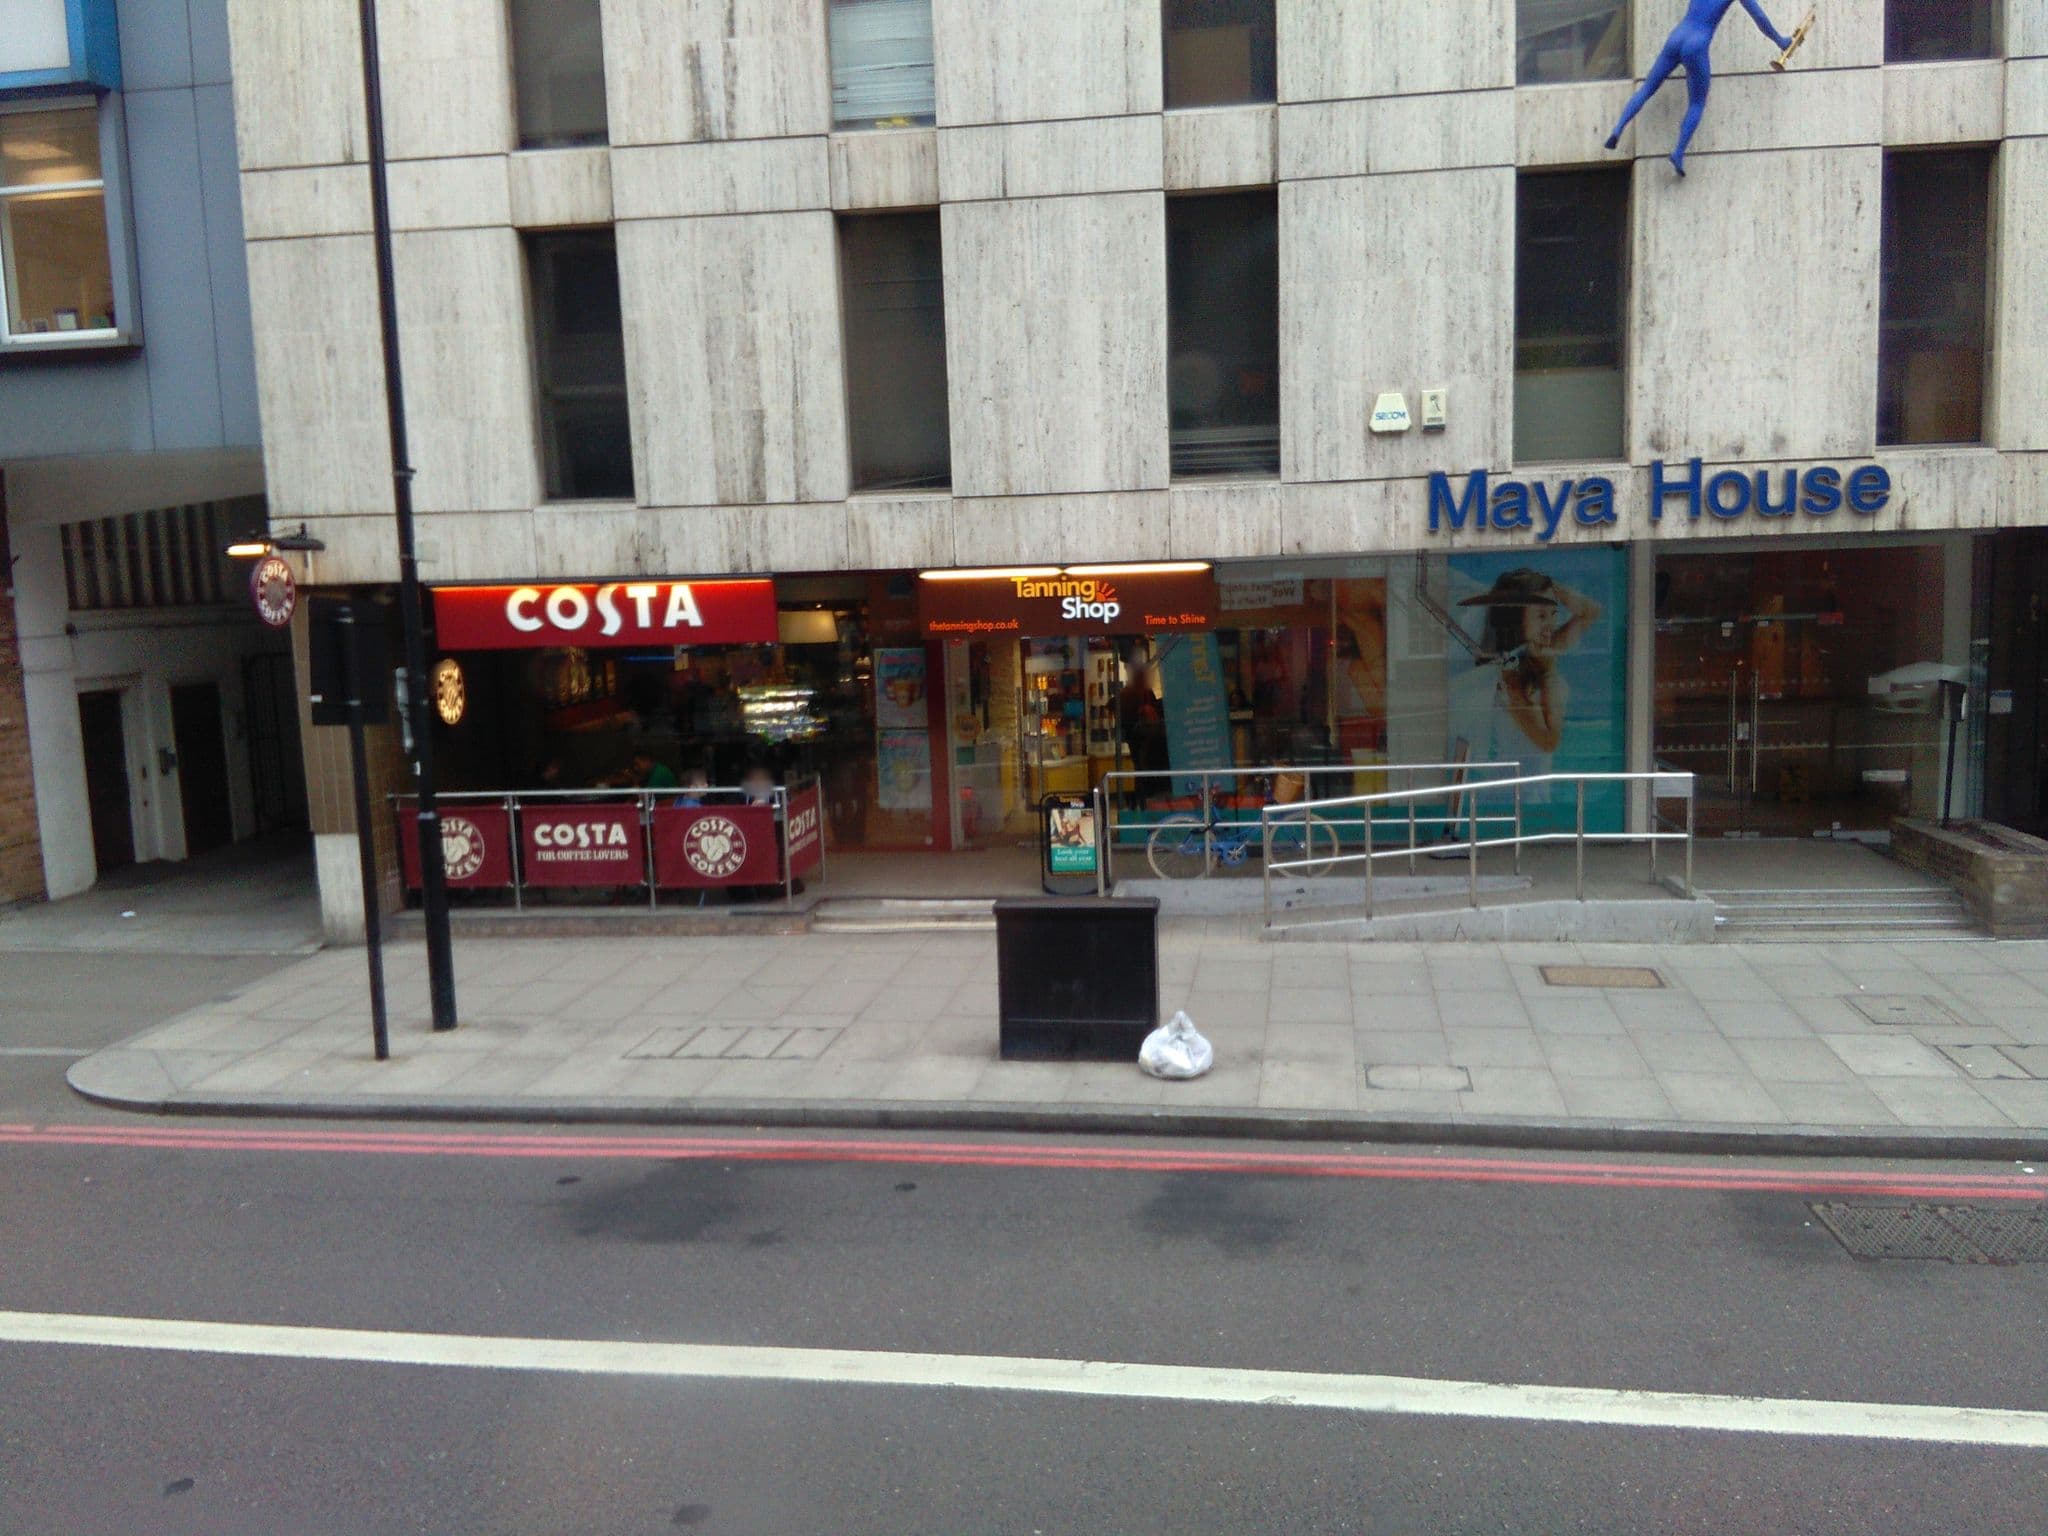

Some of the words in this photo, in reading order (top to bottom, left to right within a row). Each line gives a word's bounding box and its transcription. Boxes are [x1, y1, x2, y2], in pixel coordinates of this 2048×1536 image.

[1427, 468, 1617, 541] Maya
[1649, 457, 1891, 521] House
[1010, 576, 1096, 602] Tanning
[506, 584, 704, 636] COSTA
[1062, 597, 1120, 624] Shop
[1144, 615, 1167, 625] Time
[1168, 615, 1178, 625] to
[1180, 613, 1206, 625] Shine
[929, 618, 1018, 633] thetanningshop.co.uk
[441, 819, 474, 838] OSTA
[534, 824, 628, 848] COSTA
[691, 820, 734, 838] COSTA
[444, 854, 481, 876] FFEE
[537, 850, 556, 861] FOR
[557, 849, 592, 861] COFFEE
[594, 849, 629, 860] LOVERS
[691, 853, 742, 874] COFFEE
